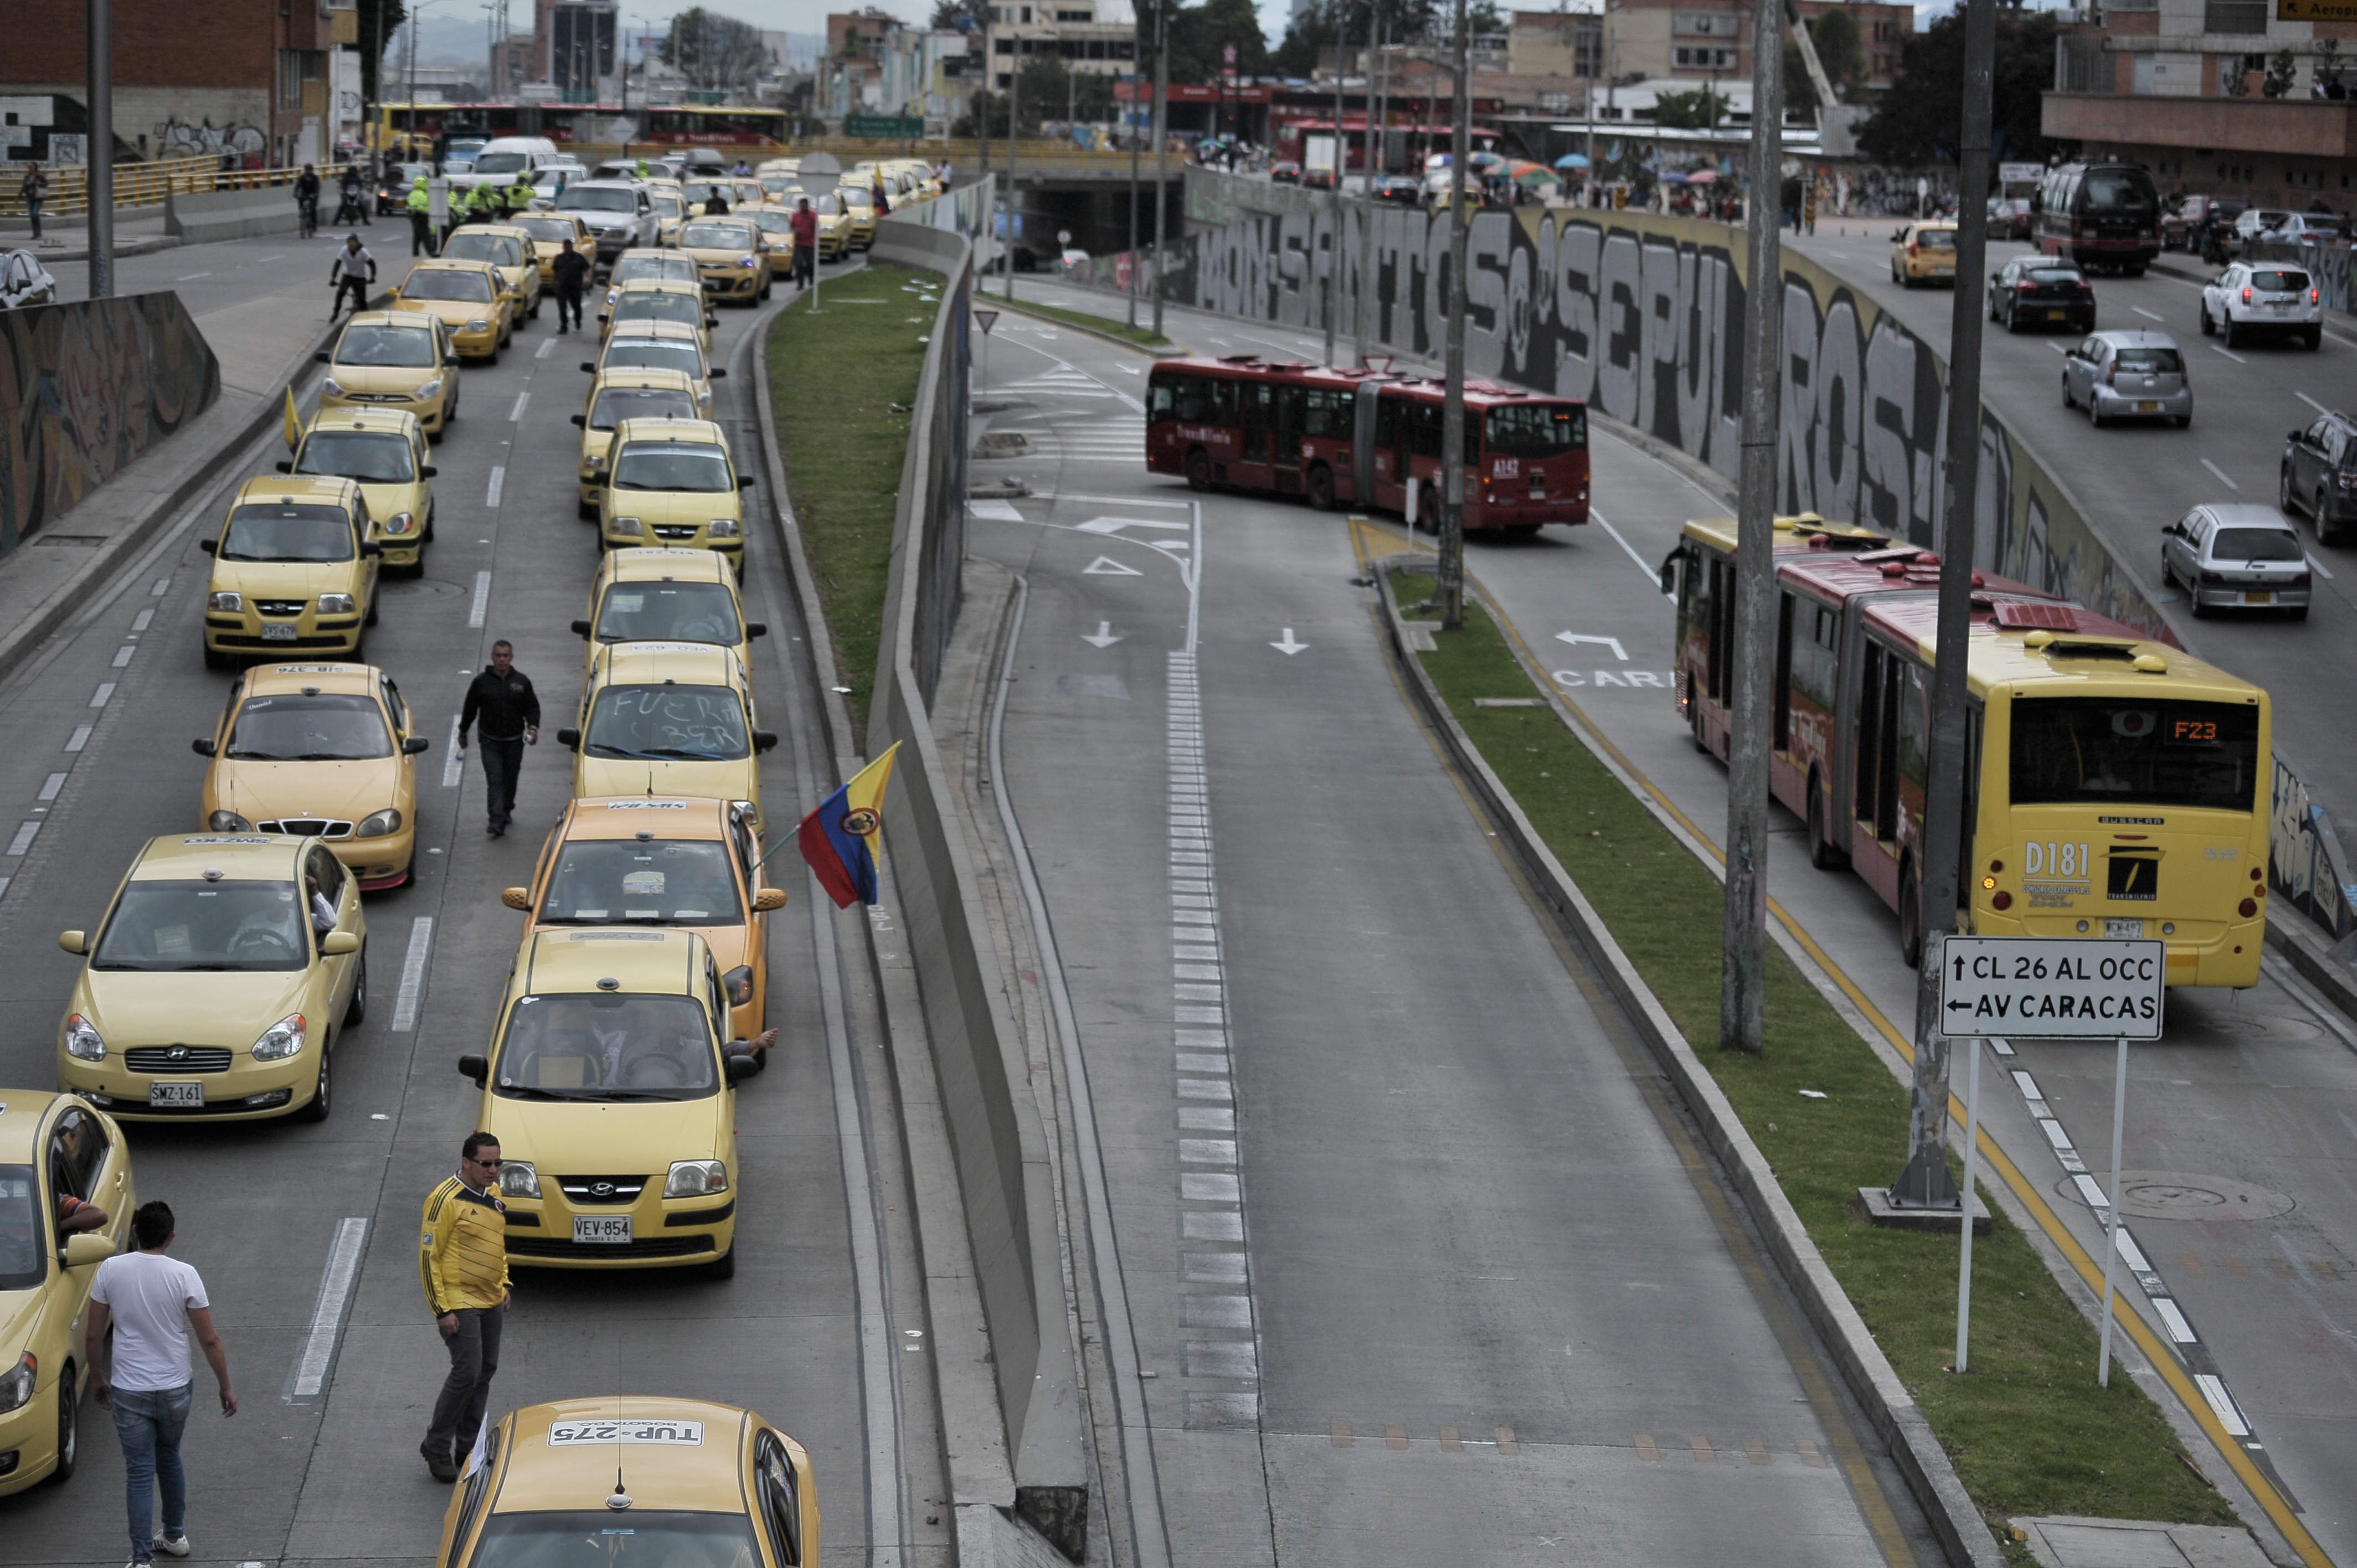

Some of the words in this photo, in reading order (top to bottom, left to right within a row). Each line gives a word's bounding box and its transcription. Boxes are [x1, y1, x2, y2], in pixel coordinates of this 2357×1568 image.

[1552, 670, 1676, 688] CAR
[614, 690, 734, 722] FUERA
[2175, 721, 2217, 740] F23
[2025, 842, 2089, 876] D181
[1973, 956, 2006, 979] CL
[2014, 957, 2048, 979] 26
[2055, 957, 2091, 980] AL
[2099, 957, 2154, 981] OCC
[1974, 994, 2011, 1018] AV
[2019, 995, 2155, 1020] CARACAS
